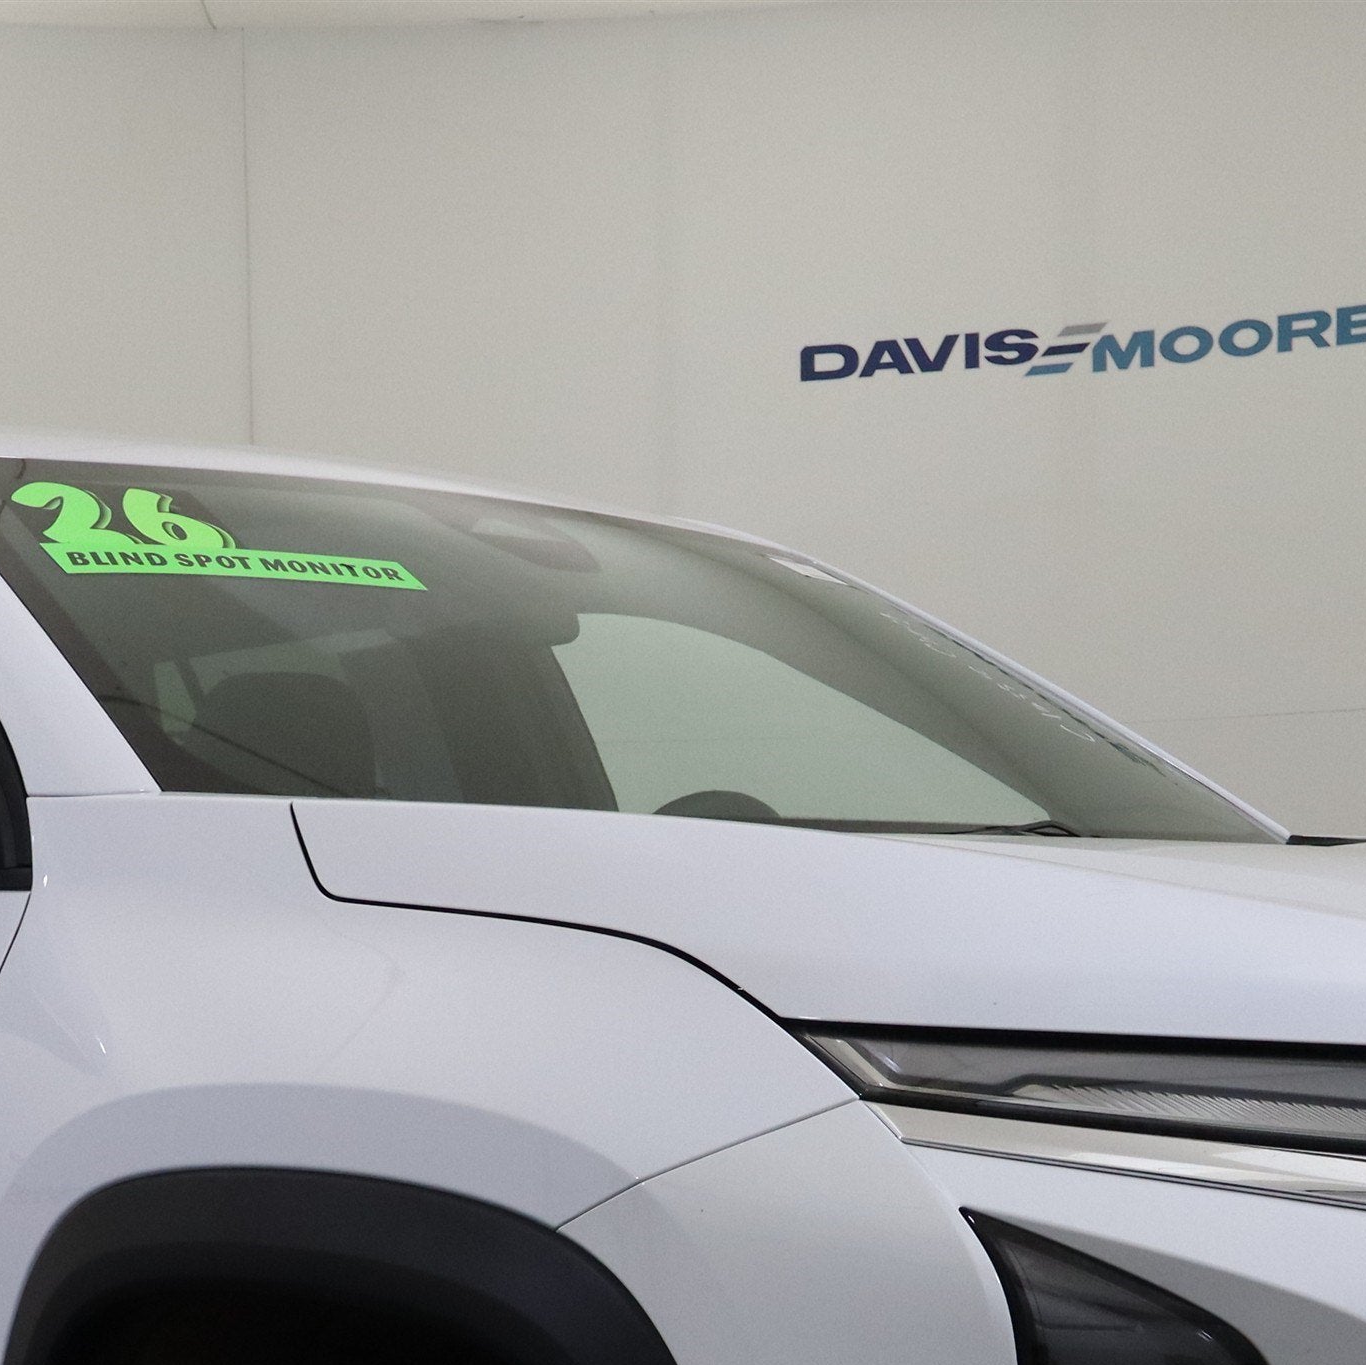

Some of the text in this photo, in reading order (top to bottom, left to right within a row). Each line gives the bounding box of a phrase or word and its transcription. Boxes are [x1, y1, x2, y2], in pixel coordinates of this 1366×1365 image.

[800, 328, 1041, 382] DAVIS
[11, 482, 236, 550] 26
[66, 551, 405, 582] BLIND SPOT MONITOR
